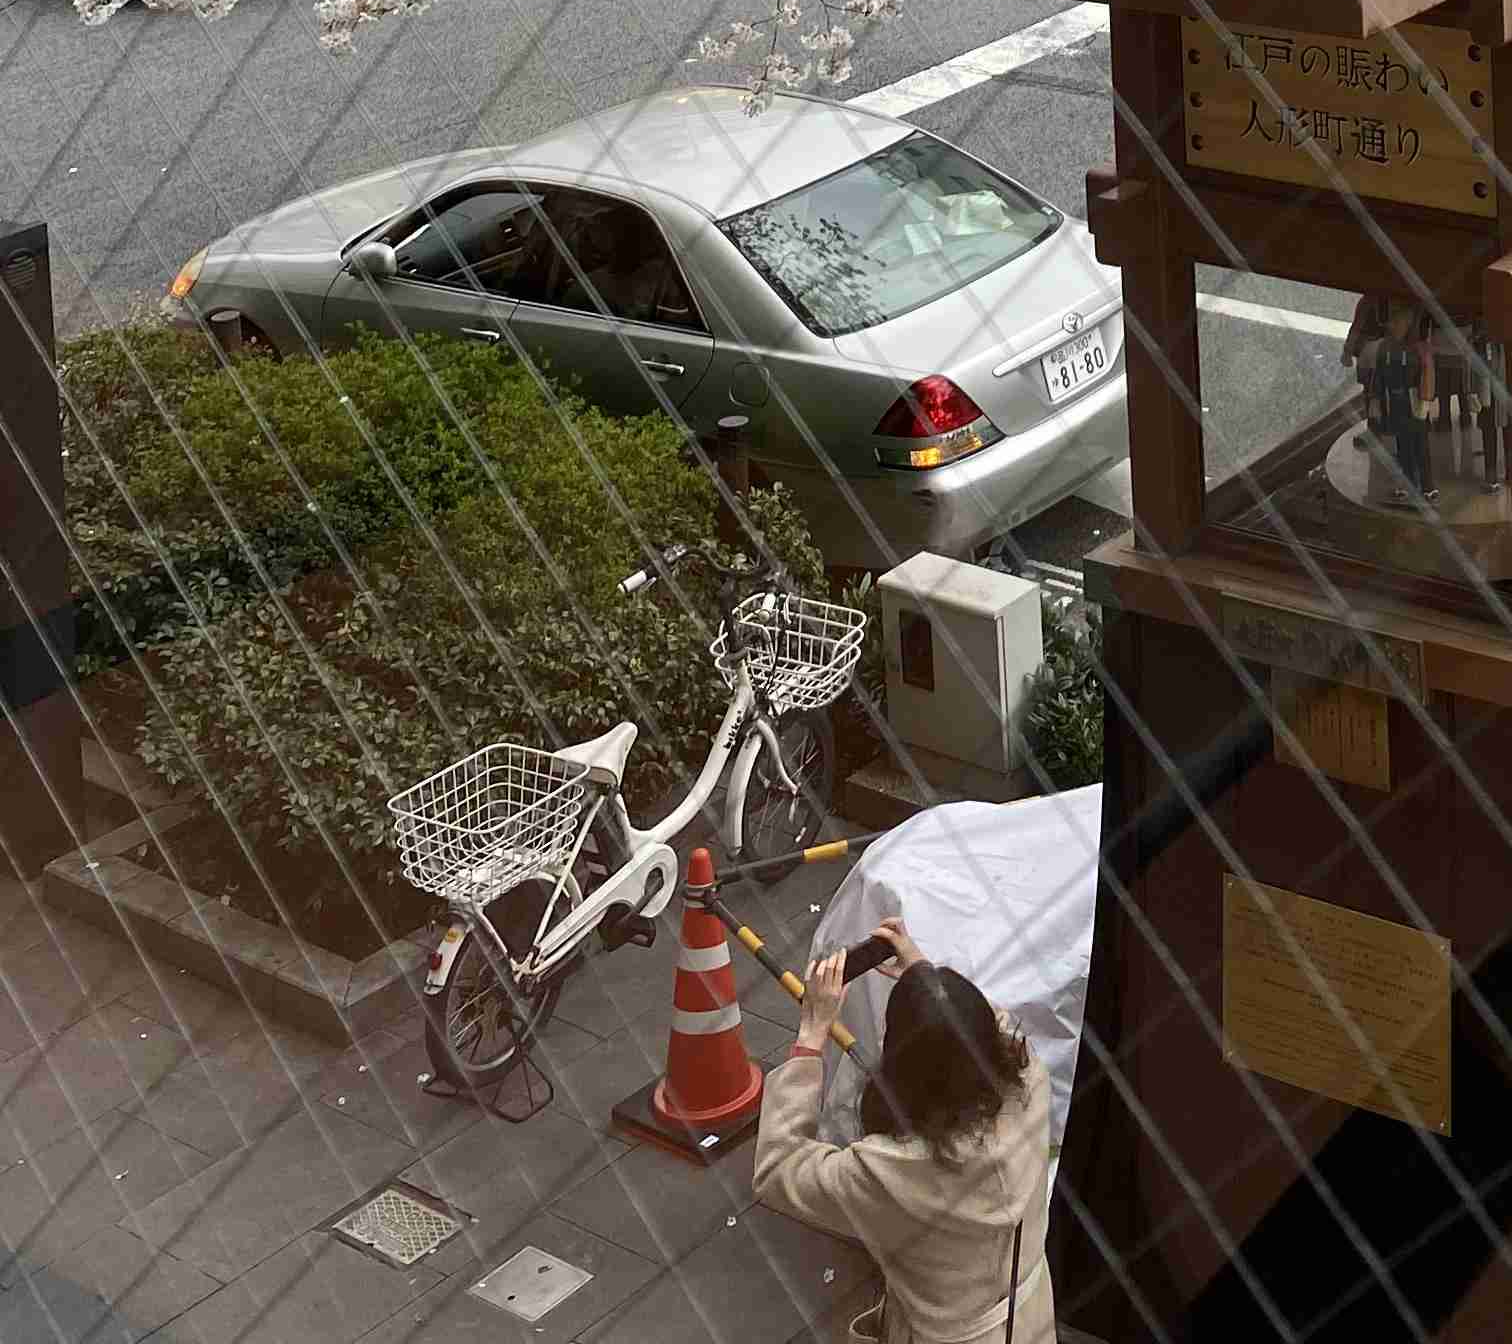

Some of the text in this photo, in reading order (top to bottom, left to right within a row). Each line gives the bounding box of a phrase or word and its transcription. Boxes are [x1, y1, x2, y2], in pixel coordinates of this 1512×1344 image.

[1240, 100, 1420, 166] 人形町通り
[1060, 346, 1104, 389] 81-80
